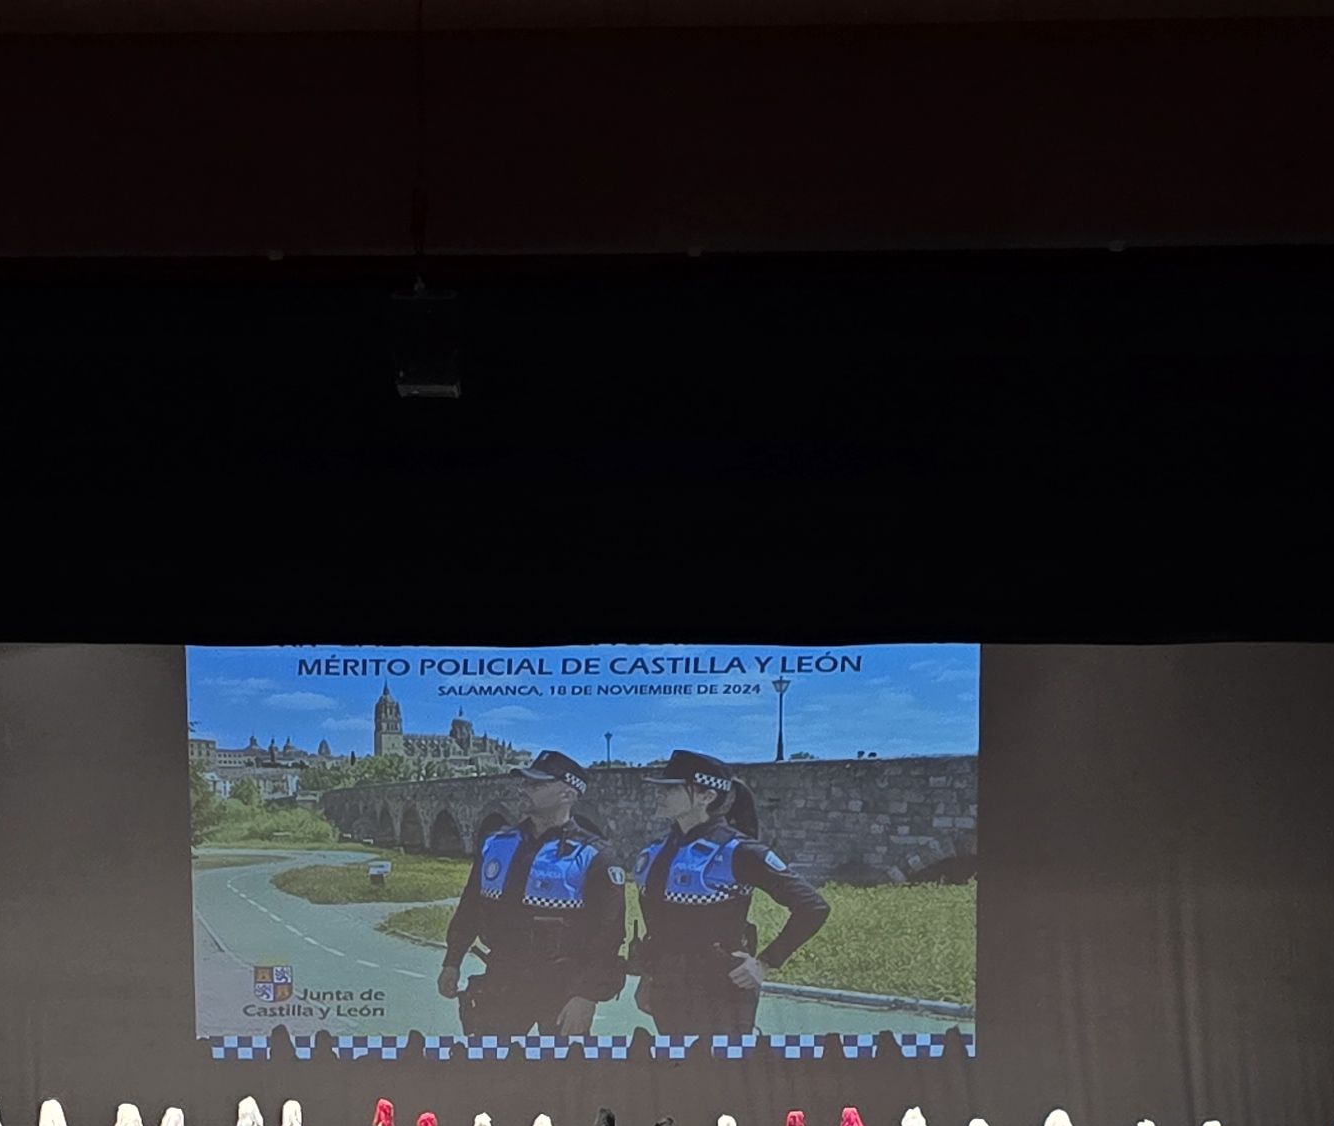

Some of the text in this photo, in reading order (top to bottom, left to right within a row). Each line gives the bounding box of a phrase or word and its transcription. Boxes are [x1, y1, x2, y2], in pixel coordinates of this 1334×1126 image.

[297, 652, 862, 676] MÉRITO POLICIAL DE CASTILLA Y LEÓN
[437, 684, 761, 697] SALAMANCA, 18 DE NOVIEMBRE DE 2024
[299, 988, 386, 1001] Junta de
[242, 1004, 385, 1020] Castilla y León
